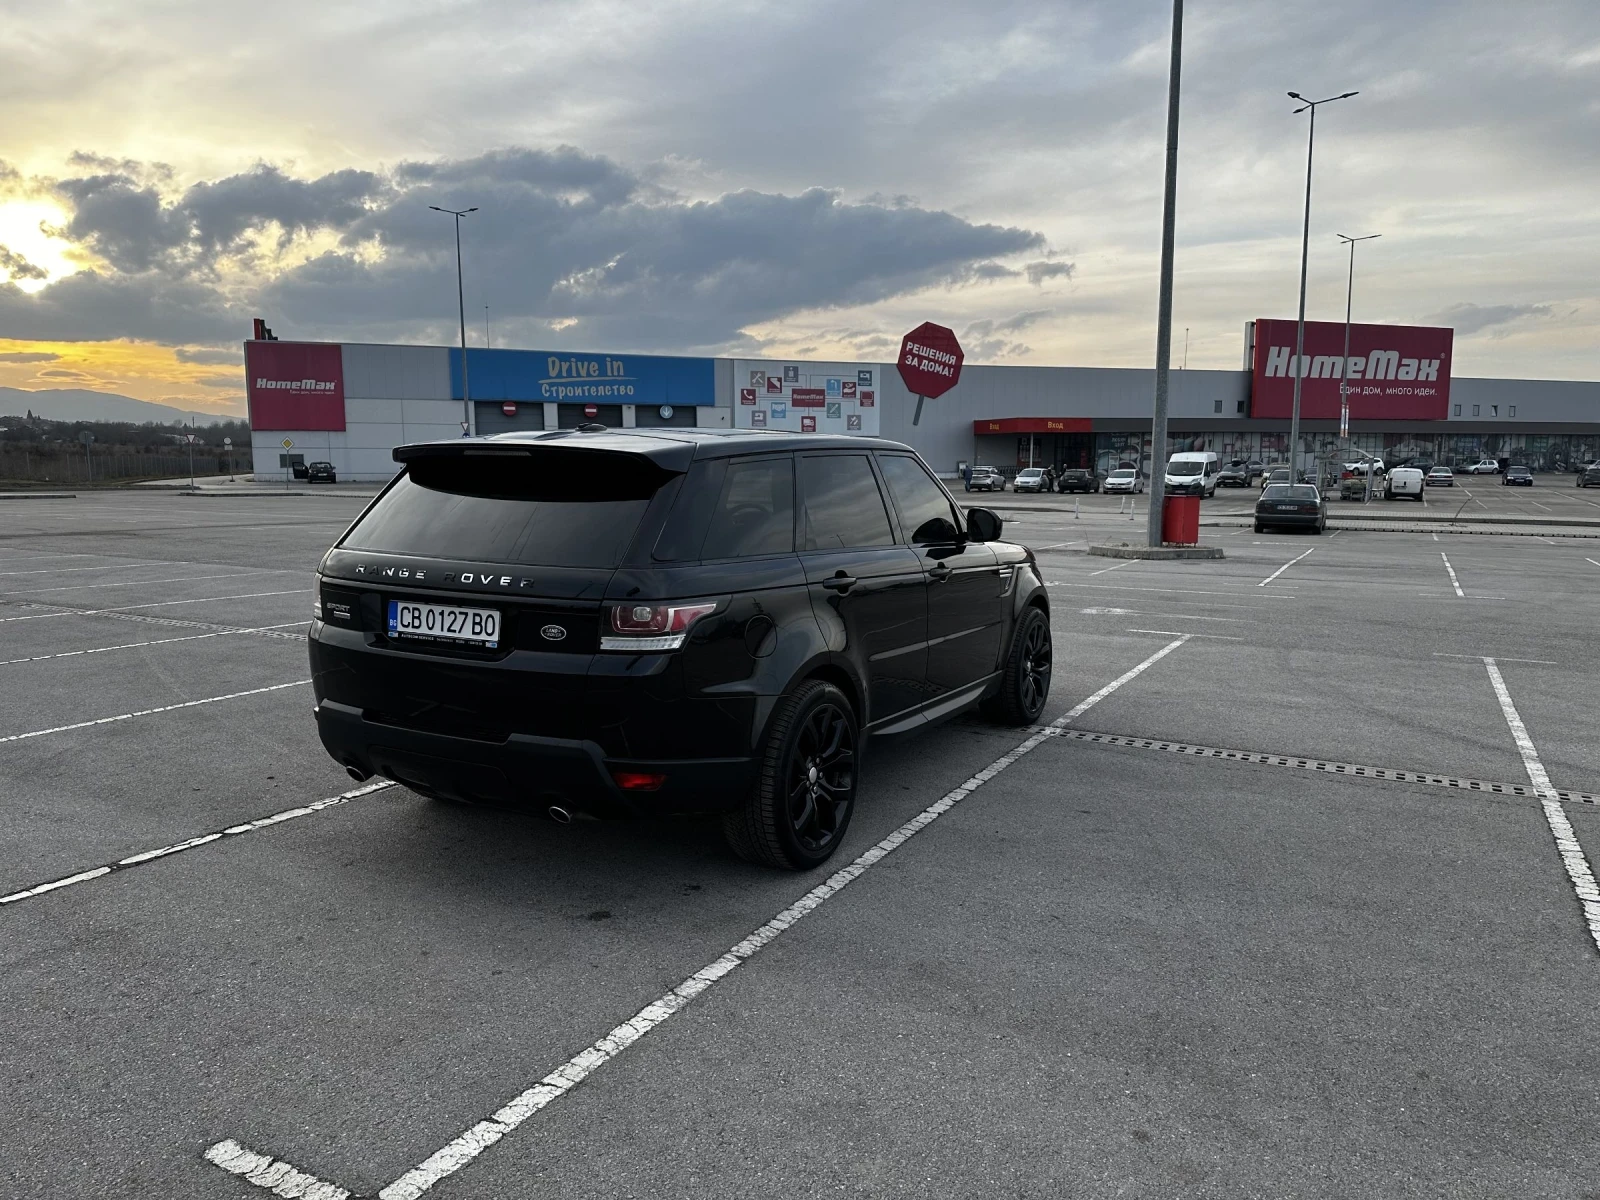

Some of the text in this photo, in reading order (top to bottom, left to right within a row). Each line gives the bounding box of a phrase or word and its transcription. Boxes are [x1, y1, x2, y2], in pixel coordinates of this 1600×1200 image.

[906, 341, 957, 366] РЕШЕНИЯ
[547, 356, 624, 377] Drive in
[905, 355, 954, 377] ЗА ДОМА!
[1265, 346, 1440, 382] HomeMax
[256, 378, 335, 390] HomeMax
[541, 383, 634, 399] Строителство
[1362, 385, 1383, 396] дом,
[1385, 387, 1413, 395] много
[1414, 387, 1438, 397] идеи.
[1047, 421, 1064, 430] Вход
[355, 564, 535, 588] RANGE ROVER
[326, 602, 350, 612] SPORT
[389, 619, 397, 627] BG
